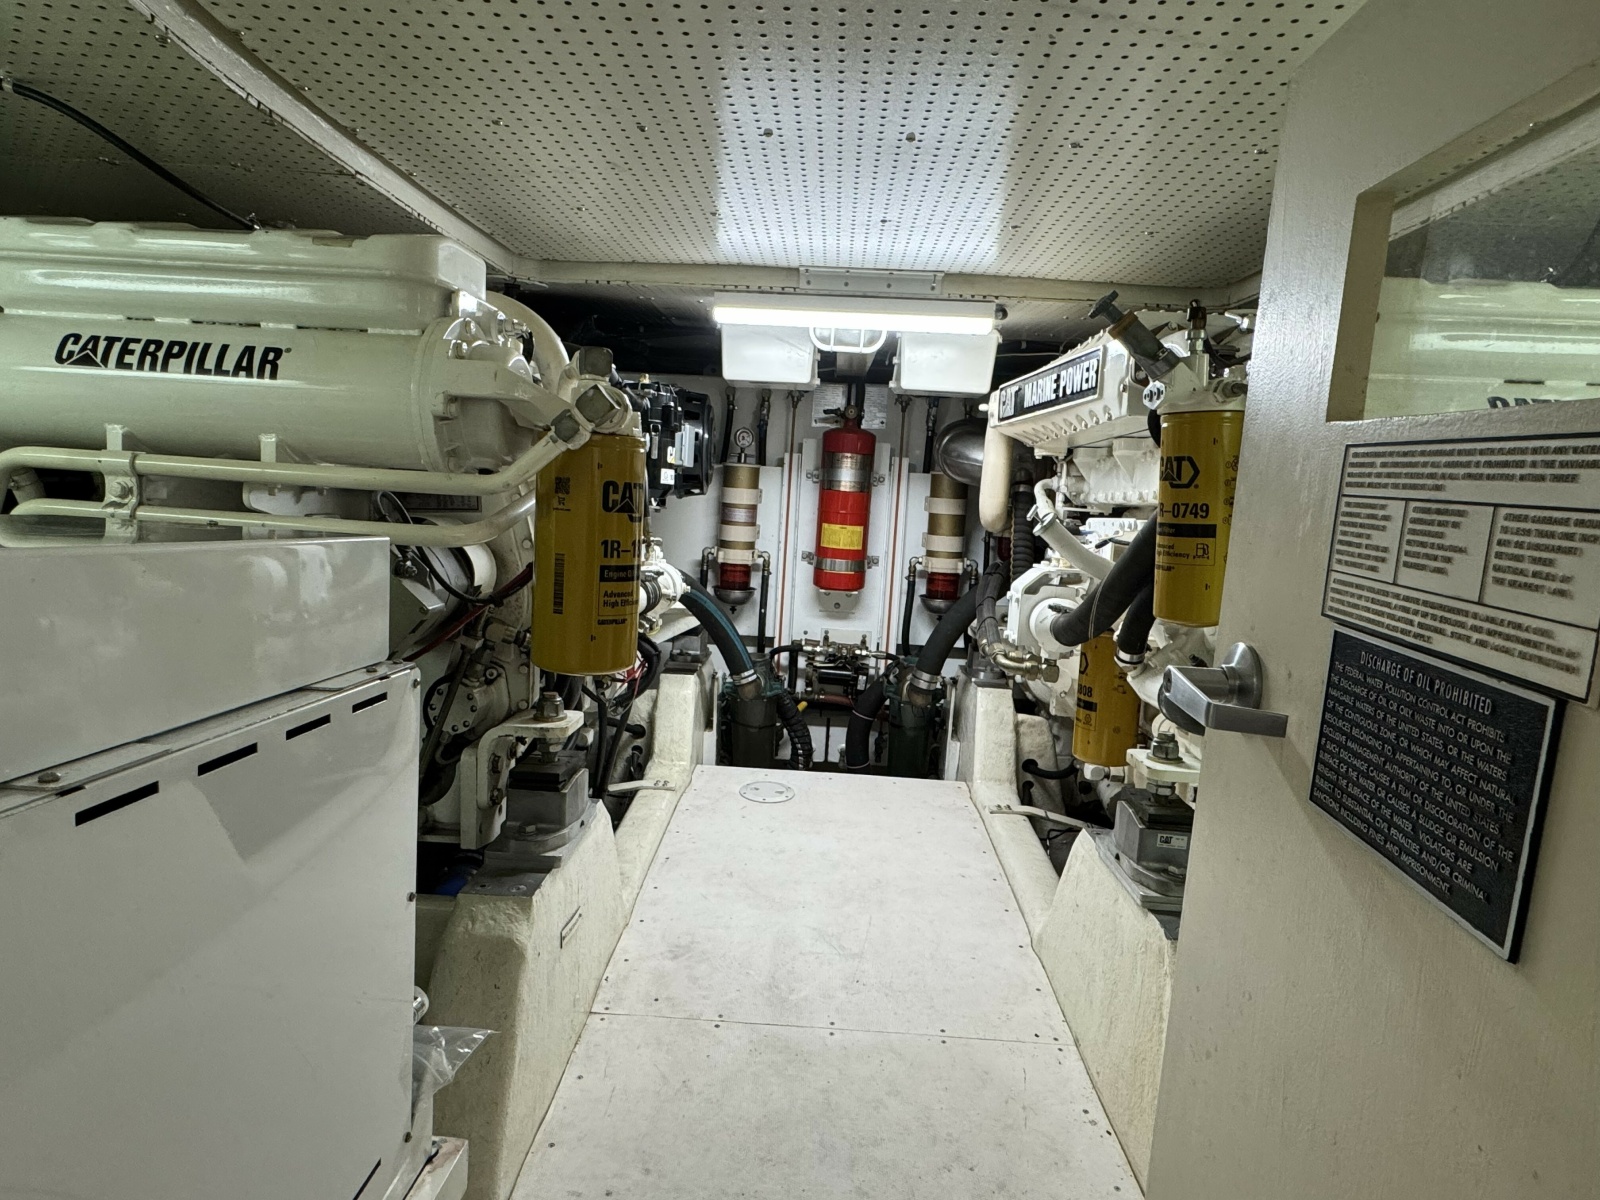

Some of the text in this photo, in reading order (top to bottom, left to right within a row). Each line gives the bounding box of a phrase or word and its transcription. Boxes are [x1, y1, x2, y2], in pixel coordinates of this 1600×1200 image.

[54, 332, 286, 380] CATERPILLAR
[1024, 373, 1058, 408] MARINE
[1059, 359, 1098, 397] POWER
[602, 480, 643, 514] CAT
[603, 600, 619, 608] High
[604, 569, 626, 579] Engine
[1330, 672, 1512, 765] THE DISCHARGE OF OIL OR OILY WASTE INTO OR UPON THE
[1334, 660, 1506, 743] THE FEDERAL WATER POLLUTION CONTROL ACT PROHIBITS
[1359, 650, 1493, 716] DISCHARGE OF OIL PROHIBITED
[1326, 698, 1334, 710] OF
[1333, 702, 1343, 715] THE
[1344, 707, 1379, 733] CONTIGUOUS
[1398, 735, 1408, 749] OR
[1409, 741, 1432, 762] WHICH
[1433, 754, 1449, 771] MAY
[1450, 762, 1478, 787] AFFECT
[1351, 725, 1383, 751] BELONGING
[1382, 743, 1394, 759] TO,
[1394, 749, 1439, 783] APPERTAINING
[1440, 774, 1453, 793] TO,
[1454, 782, 1467, 799] OR
[1468, 790, 1495, 815] UNDER
[1497, 806, 1514, 826] THE
[1354, 698, 1375, 716] WATERS
[1375, 708, 1385, 721] OF
[1385, 713, 1397, 727] THE
[1397, 719, 1419, 739] UNITED
[1420, 730, 1445, 753] STATES,
[1446, 743, 1459, 759] OR
[1460, 750, 1475, 767] THE
[1475, 757, 1508, 783] WATERS
[1320, 735, 1514, 865] IF SUCH DISCHARGE CAUSES A FILM OR DISCOLORATION OF THE
[1338, 761, 1347, 775] OF
[1347, 766, 1358, 782] THE
[1357, 773, 1376, 794] WATER
[1376, 785, 1386, 800] OR
[1386, 792, 1410, 817] CAUSES
[1410, 807, 1417, 822] A
[1418, 812, 1445, 840] SLUDGE
[1444, 830, 1457, 848] OR
[1458, 838, 1499, 876] EMULSION
[1160, 836, 1173, 844] CAT
